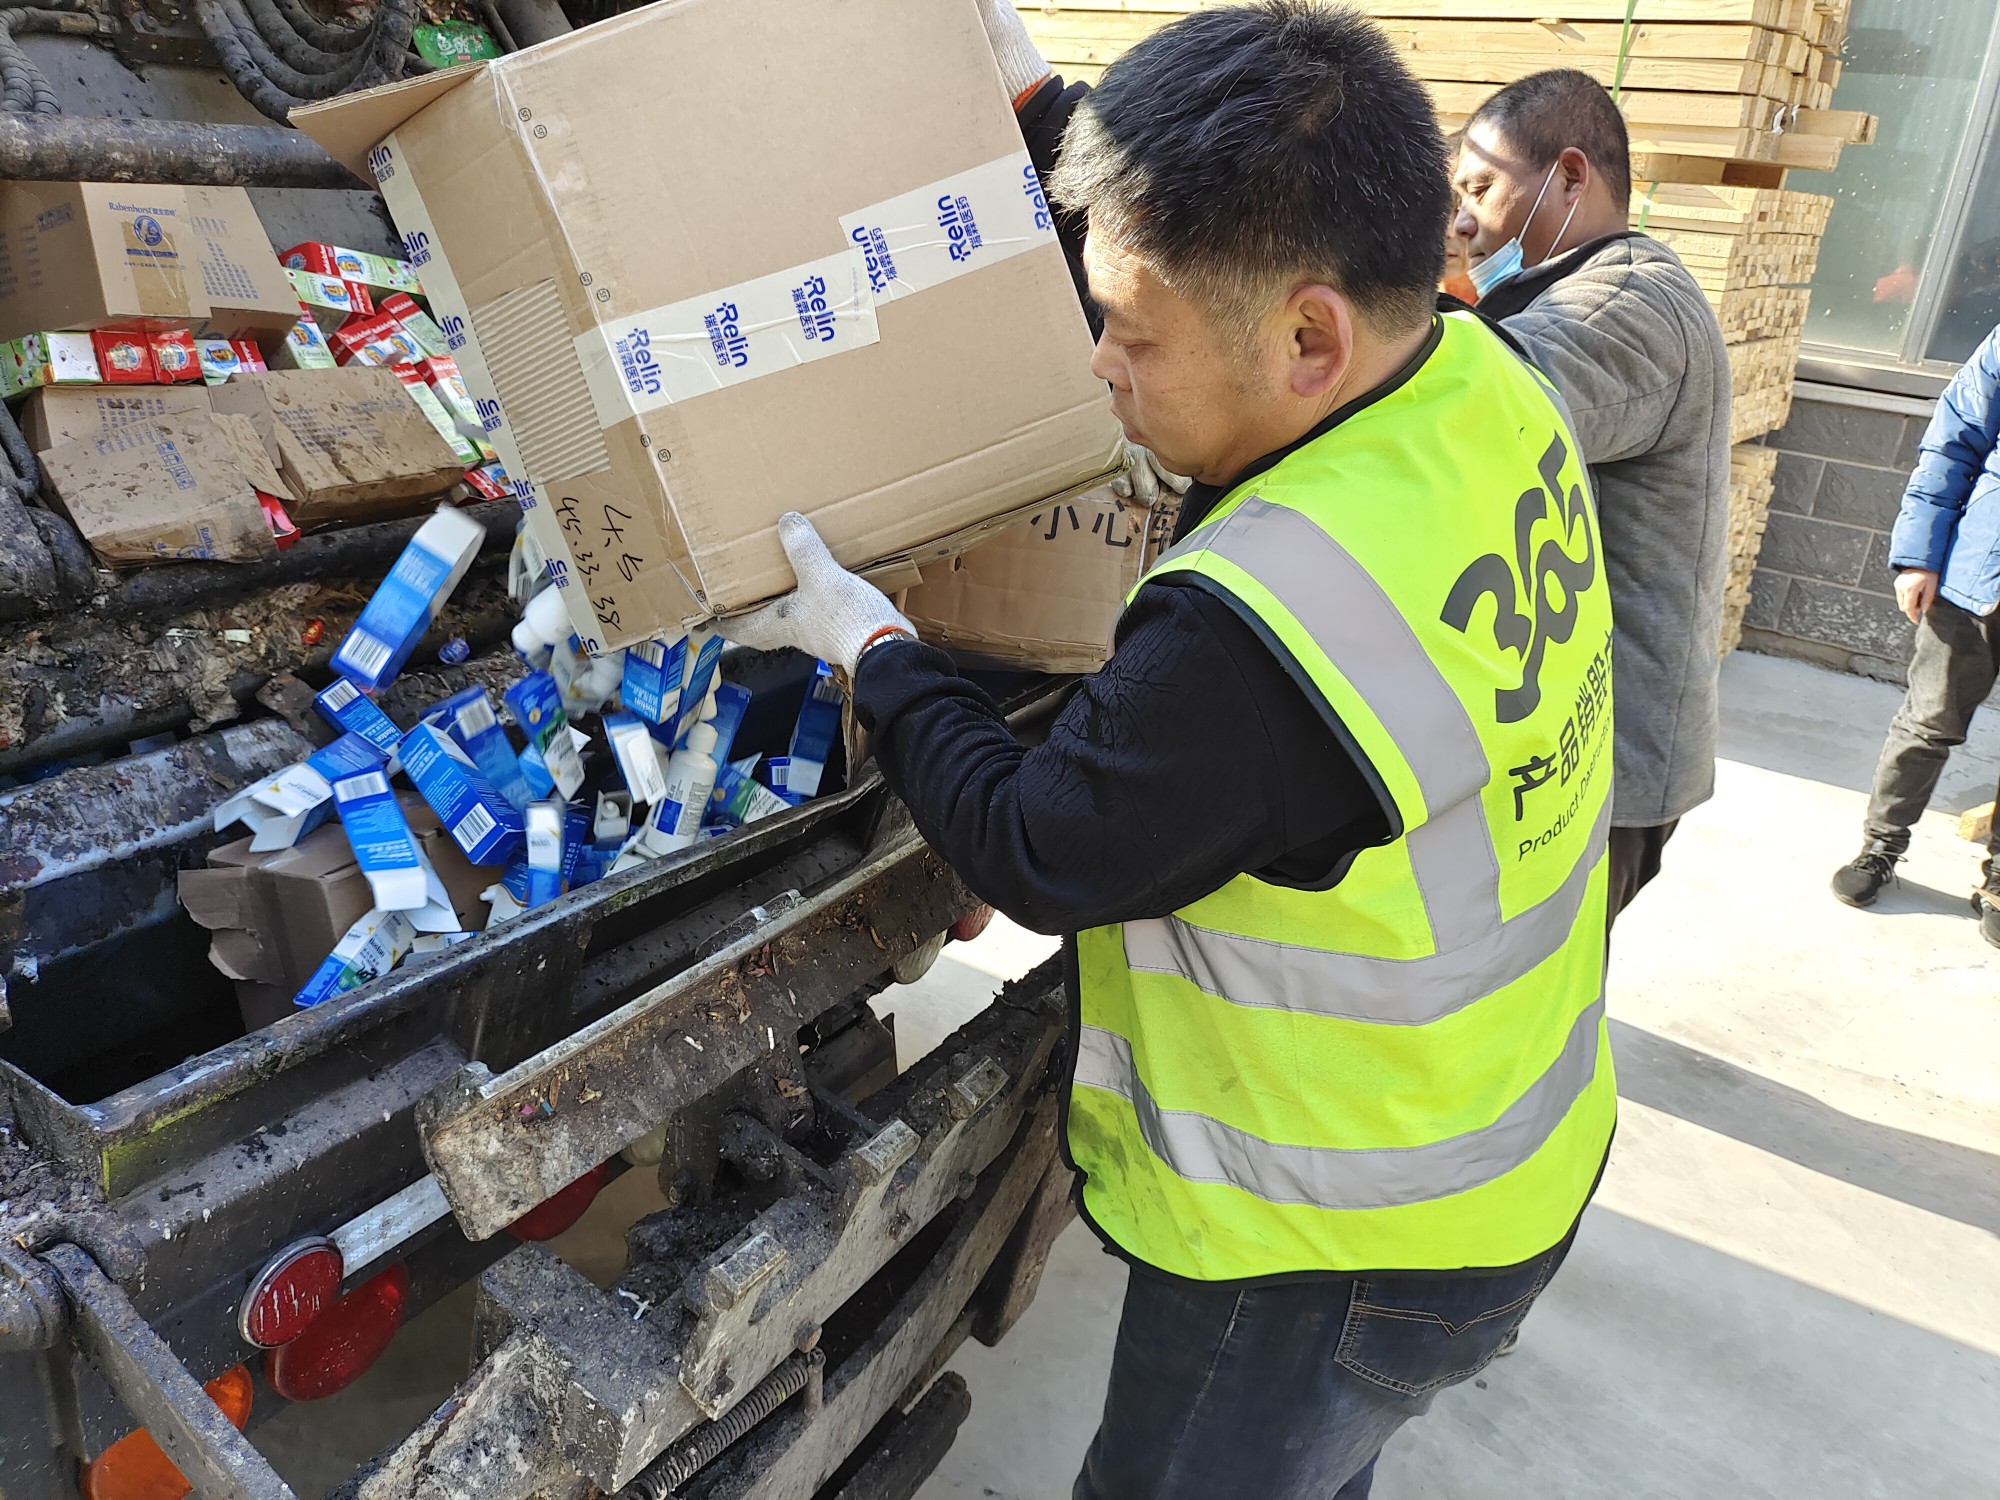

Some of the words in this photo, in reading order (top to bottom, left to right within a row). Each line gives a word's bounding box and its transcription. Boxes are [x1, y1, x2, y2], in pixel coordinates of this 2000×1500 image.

[108, 201, 152, 215] Rabenhorst
[938, 195, 971, 262] Relin
[955, 196, 983, 250] 瑞霖医药
[716, 302, 748, 368] Relin
[791, 287, 817, 340] 瑞霖医药
[803, 275, 836, 342] Relin
[627, 327, 662, 394] Relin
[1440, 430, 1595, 724] 365
[1518, 790, 1579, 862] Product
